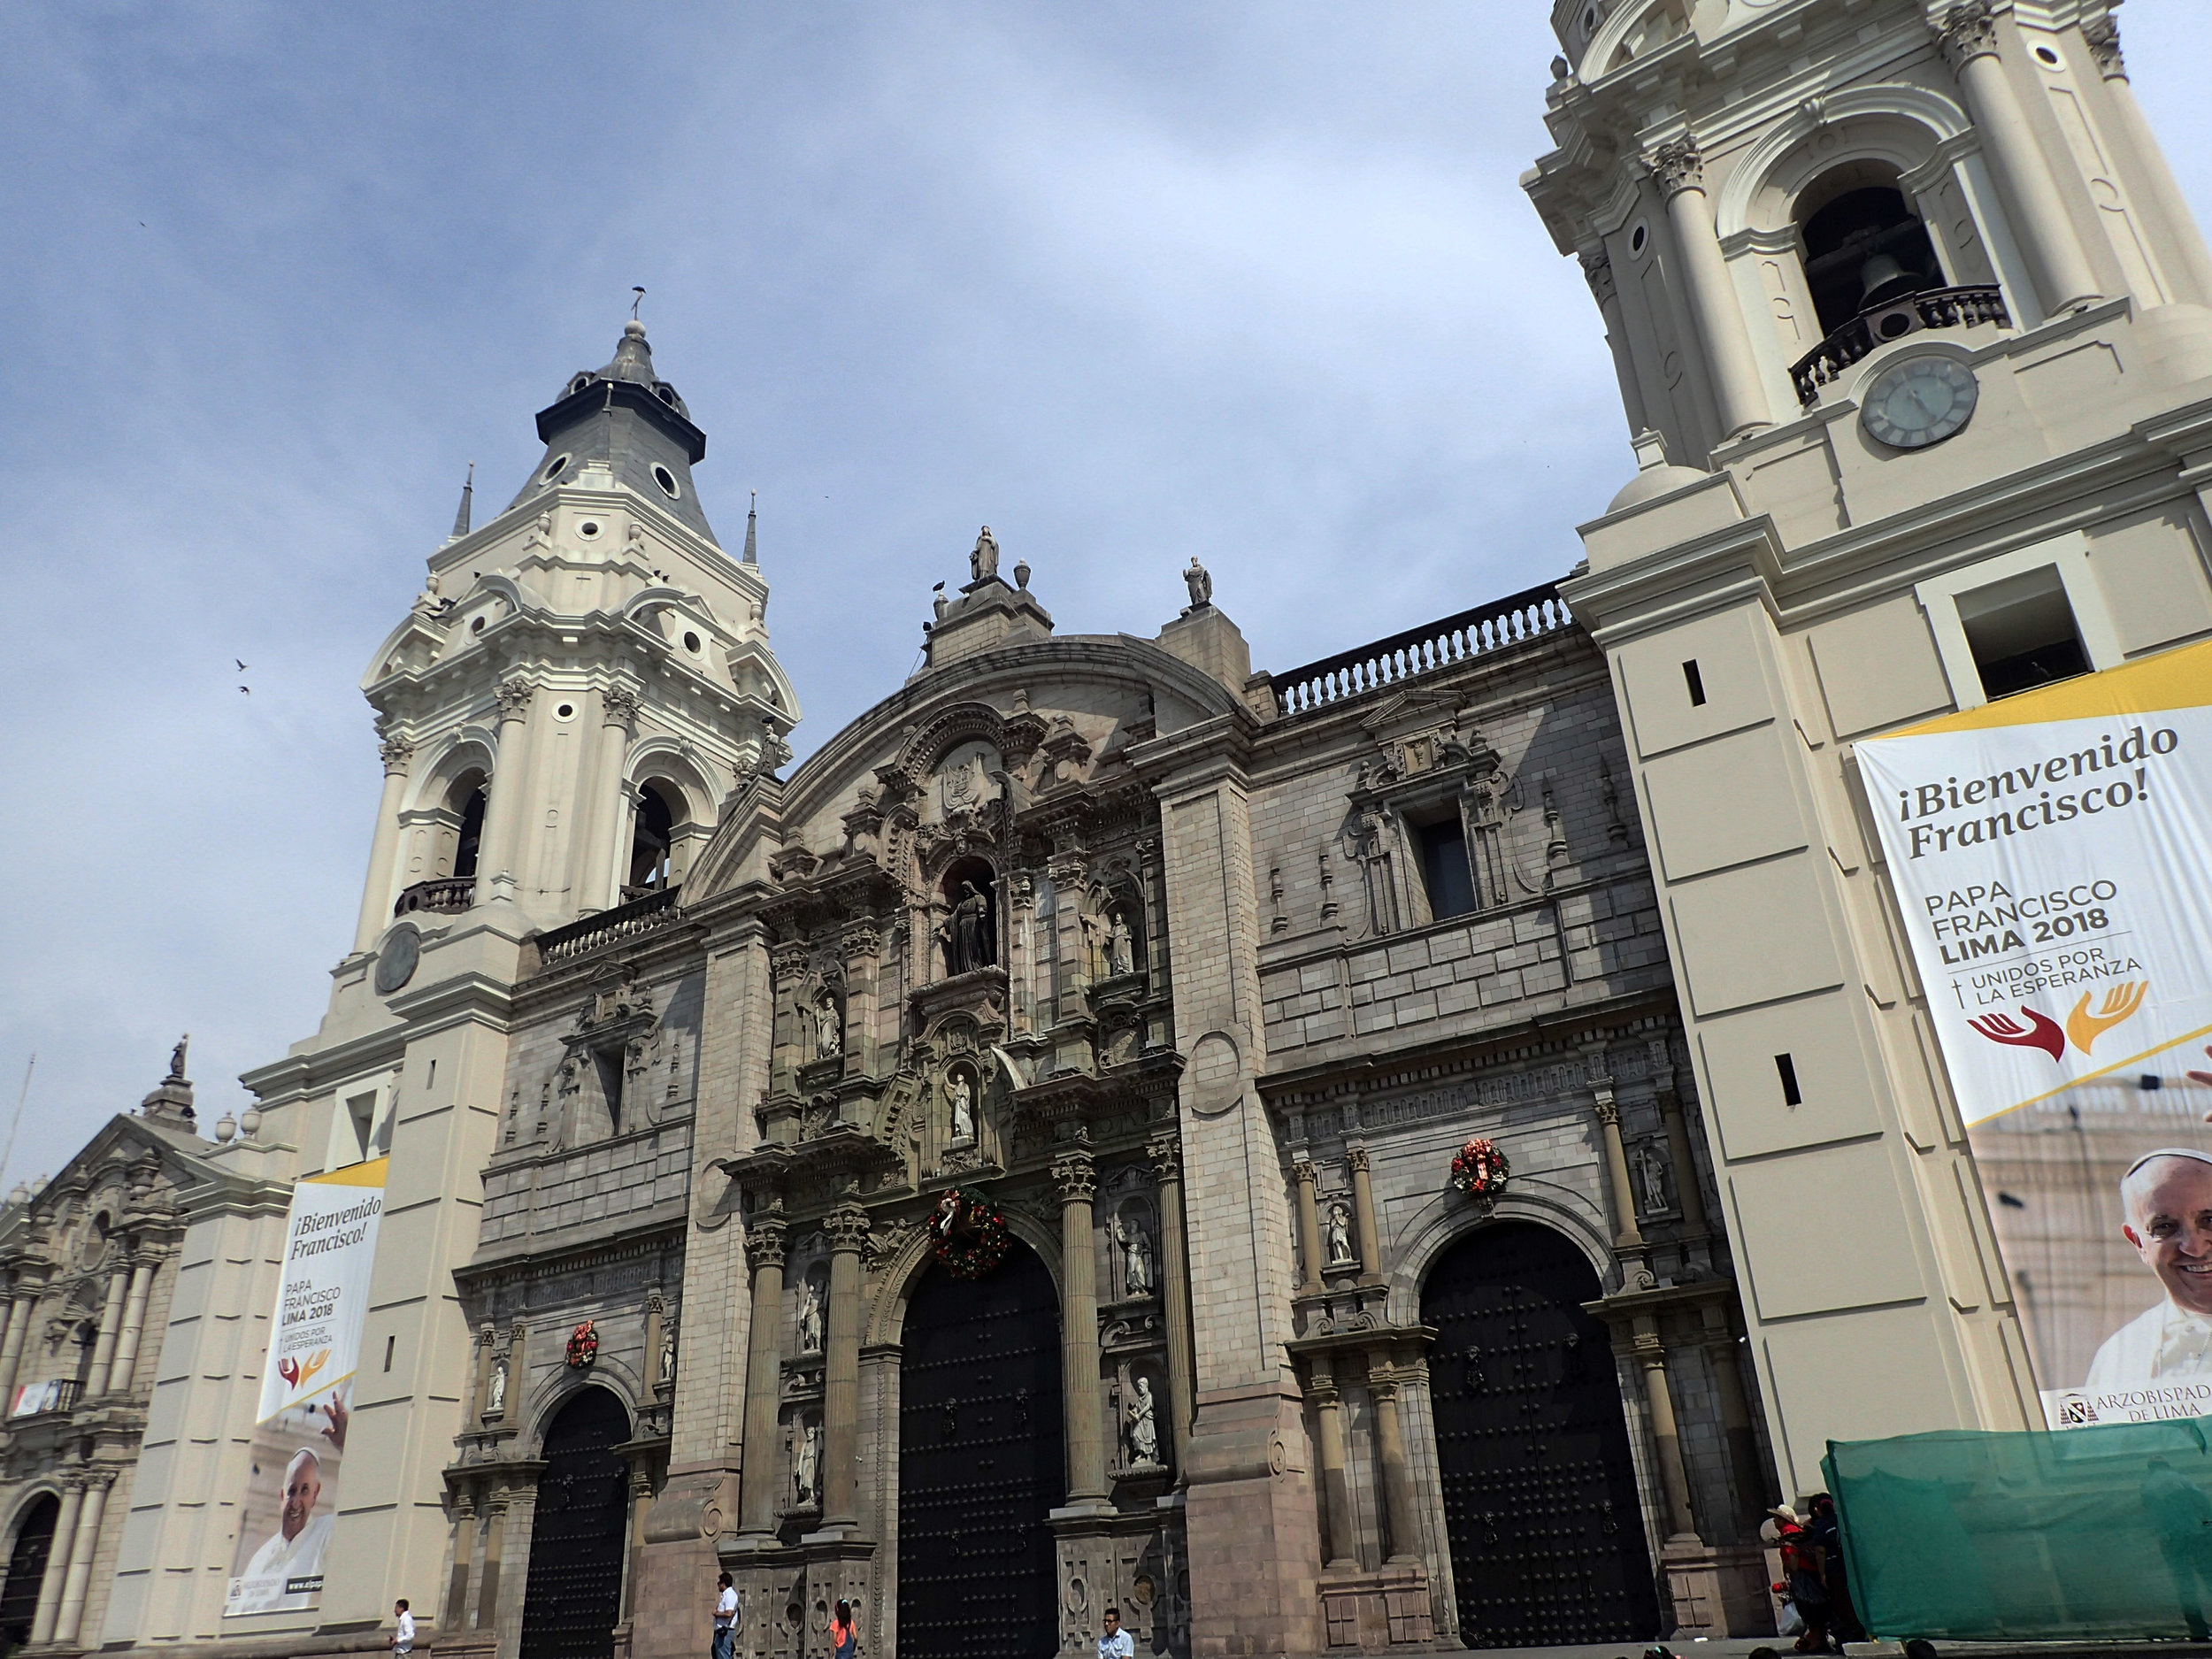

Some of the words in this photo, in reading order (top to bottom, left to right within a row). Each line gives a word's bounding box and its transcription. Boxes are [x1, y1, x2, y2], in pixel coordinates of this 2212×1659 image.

[1899, 726, 2178, 822] ¡Bienvenido
[1908, 766, 2148, 860] Francisco!
[1924, 880, 2012, 916] PAPA
[1932, 879, 2117, 941] FRANCISCO
[1939, 929, 2026, 965] LIMA
[2032, 908, 2109, 943] 2018
[1971, 959, 2053, 989] UNIDOS
[2057, 948, 2105, 970] POR
[1976, 988, 2005, 1005] LA
[2010, 957, 2143, 998] ESPERANZA
[295, 1195, 381, 1237] ¡Bienvenido
[290, 1221, 368, 1261] Francisco!
[284, 1286, 342, 1311] FRANCISCO
[286, 1279, 312, 1296] PAPA
[281, 1310, 306, 1326] LIMA
[309, 1303, 334, 1320] 2018
[311, 1326, 326, 1337] POR
[2129, 1409, 2150, 1423] DE
[2152, 1402, 2202, 1420] LIMA
